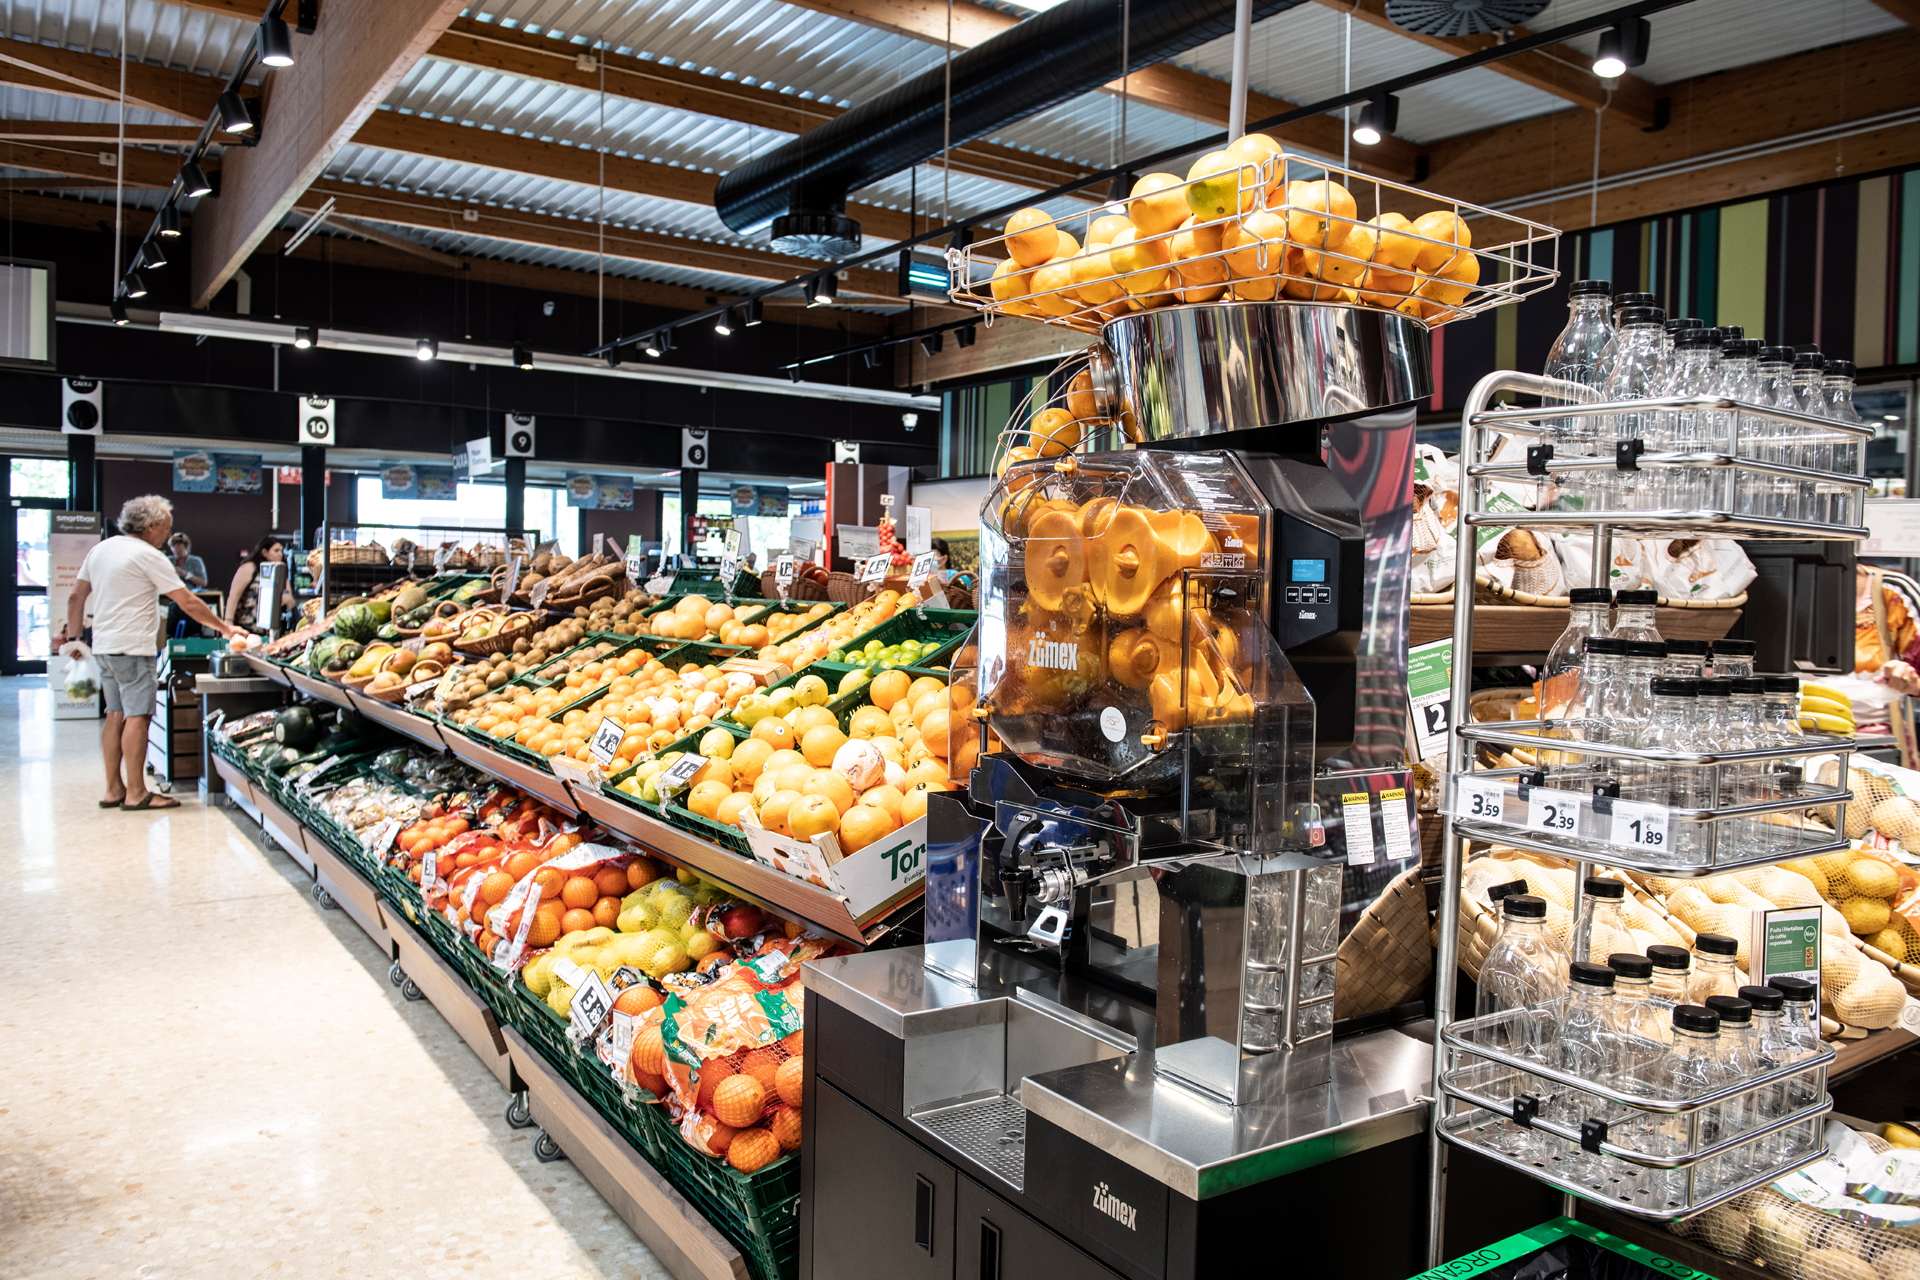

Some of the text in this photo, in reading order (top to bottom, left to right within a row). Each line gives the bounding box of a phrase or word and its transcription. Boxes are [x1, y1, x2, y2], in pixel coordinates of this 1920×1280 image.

[309, 421, 327, 434] 10
[518, 436, 527, 448] 9
[452, 452, 468, 470] CAIXA
[694, 449, 702, 460] 8
[56, 514, 96, 523] smartbox
[1105, 714, 1120, 726] ASP
[1429, 703, 1448, 732] 2
[1385, 790, 1404, 799] WARNING
[1471, 793, 1500, 817] 3,59
[1543, 804, 1575, 830] 2,39
[1629, 819, 1664, 845] 1,89
